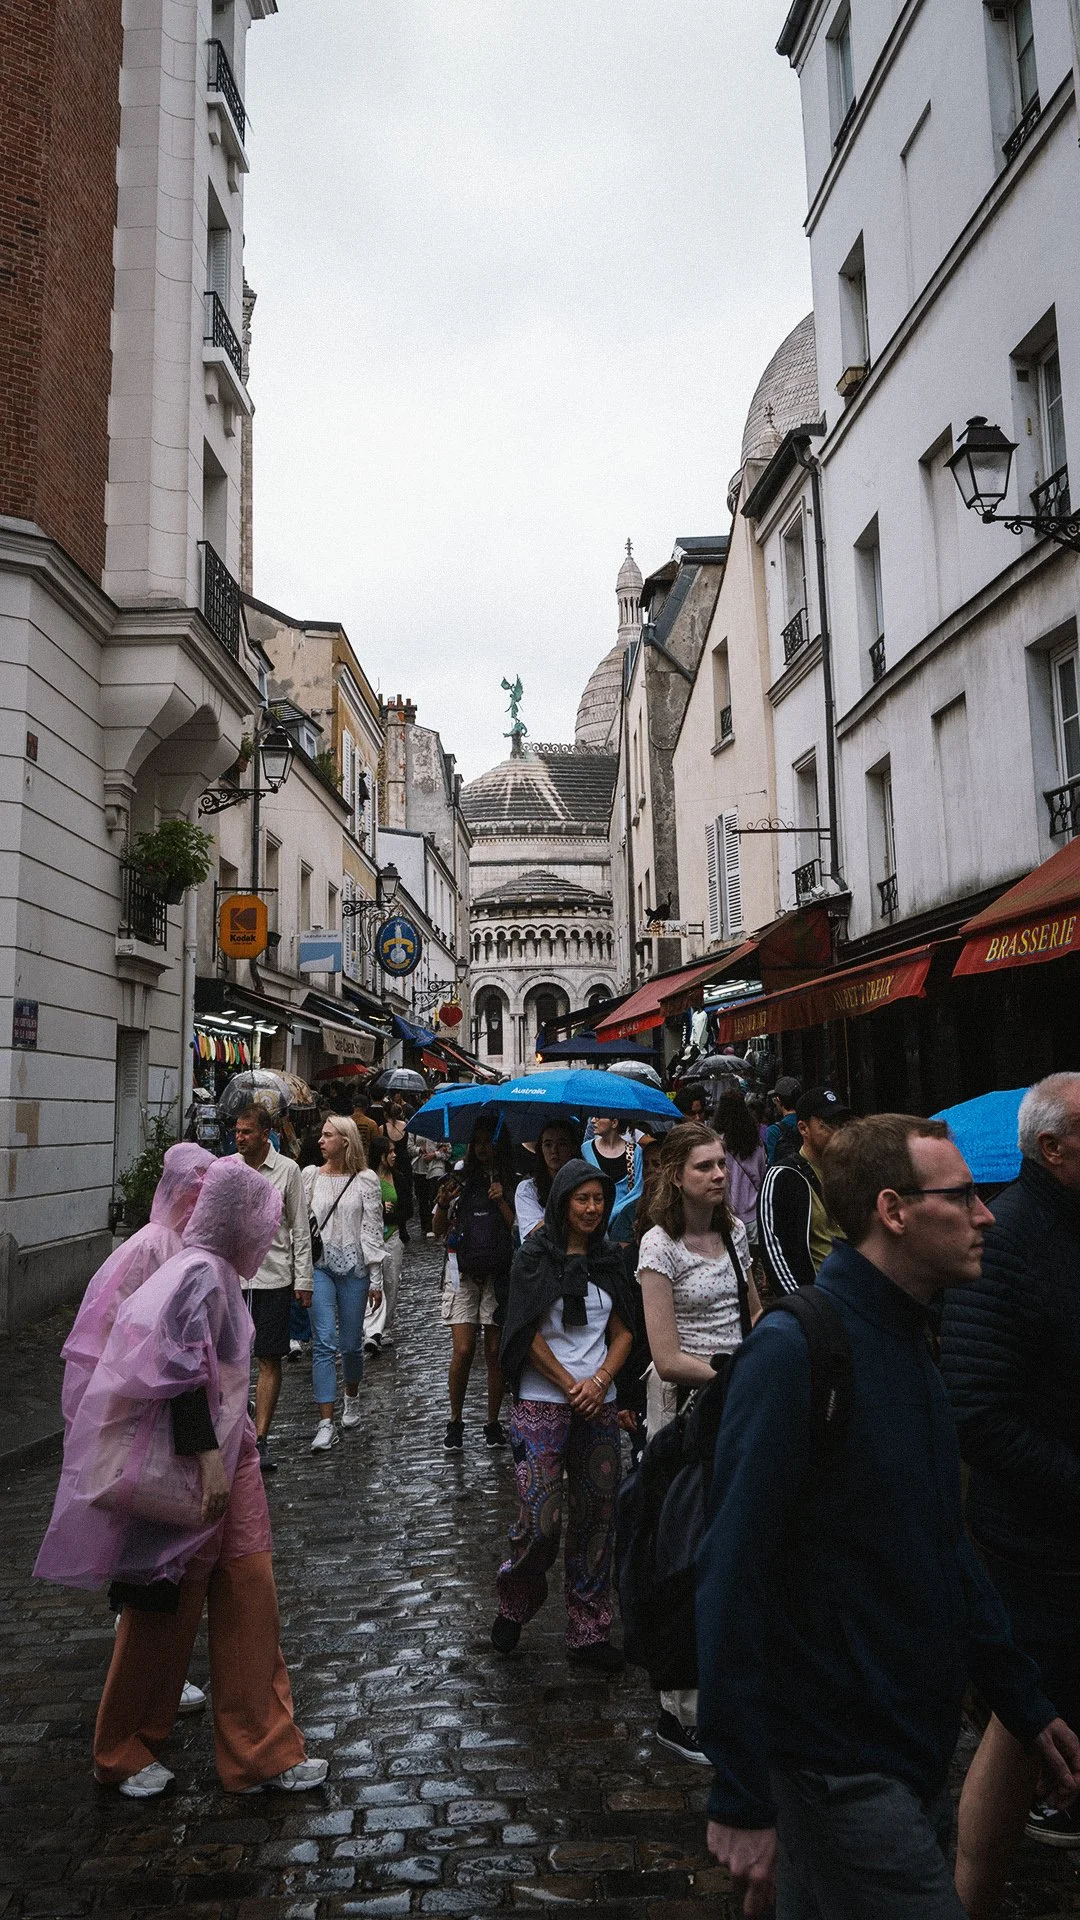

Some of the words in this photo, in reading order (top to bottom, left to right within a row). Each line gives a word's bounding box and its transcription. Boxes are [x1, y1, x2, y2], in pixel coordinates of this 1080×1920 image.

[230, 934, 257, 942] Kodak
[985, 915, 1077, 963] BRASSERIE
[510, 1087, 547, 1095] Australia
